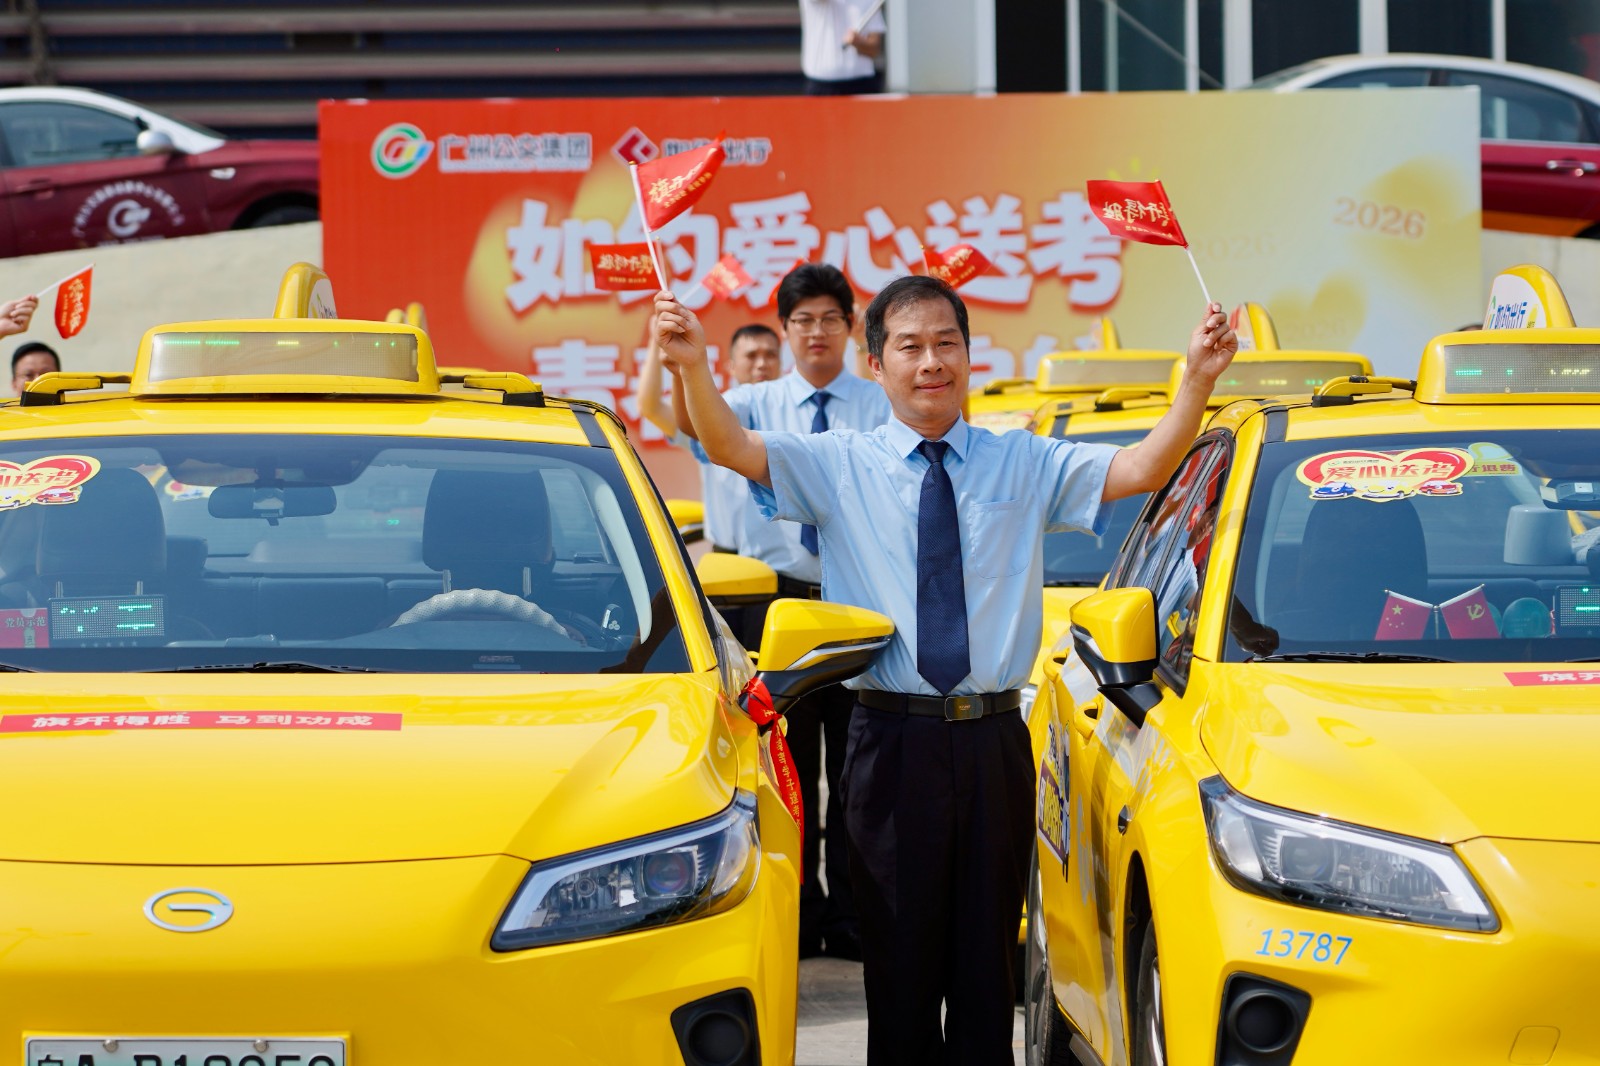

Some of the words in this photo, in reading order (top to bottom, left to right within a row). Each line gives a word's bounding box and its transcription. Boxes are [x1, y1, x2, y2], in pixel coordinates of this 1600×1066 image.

[442, 134, 589, 160] 广州公交集团
[1334, 197, 1426, 239] 2026
[506, 190, 1123, 311] 如约爱心送考
[1327, 461, 1451, 480] 爱心送考
[33, 715, 191, 726] 旗开得胜
[216, 715, 373, 726] 马到功成
[1256, 928, 1353, 965] 13787
